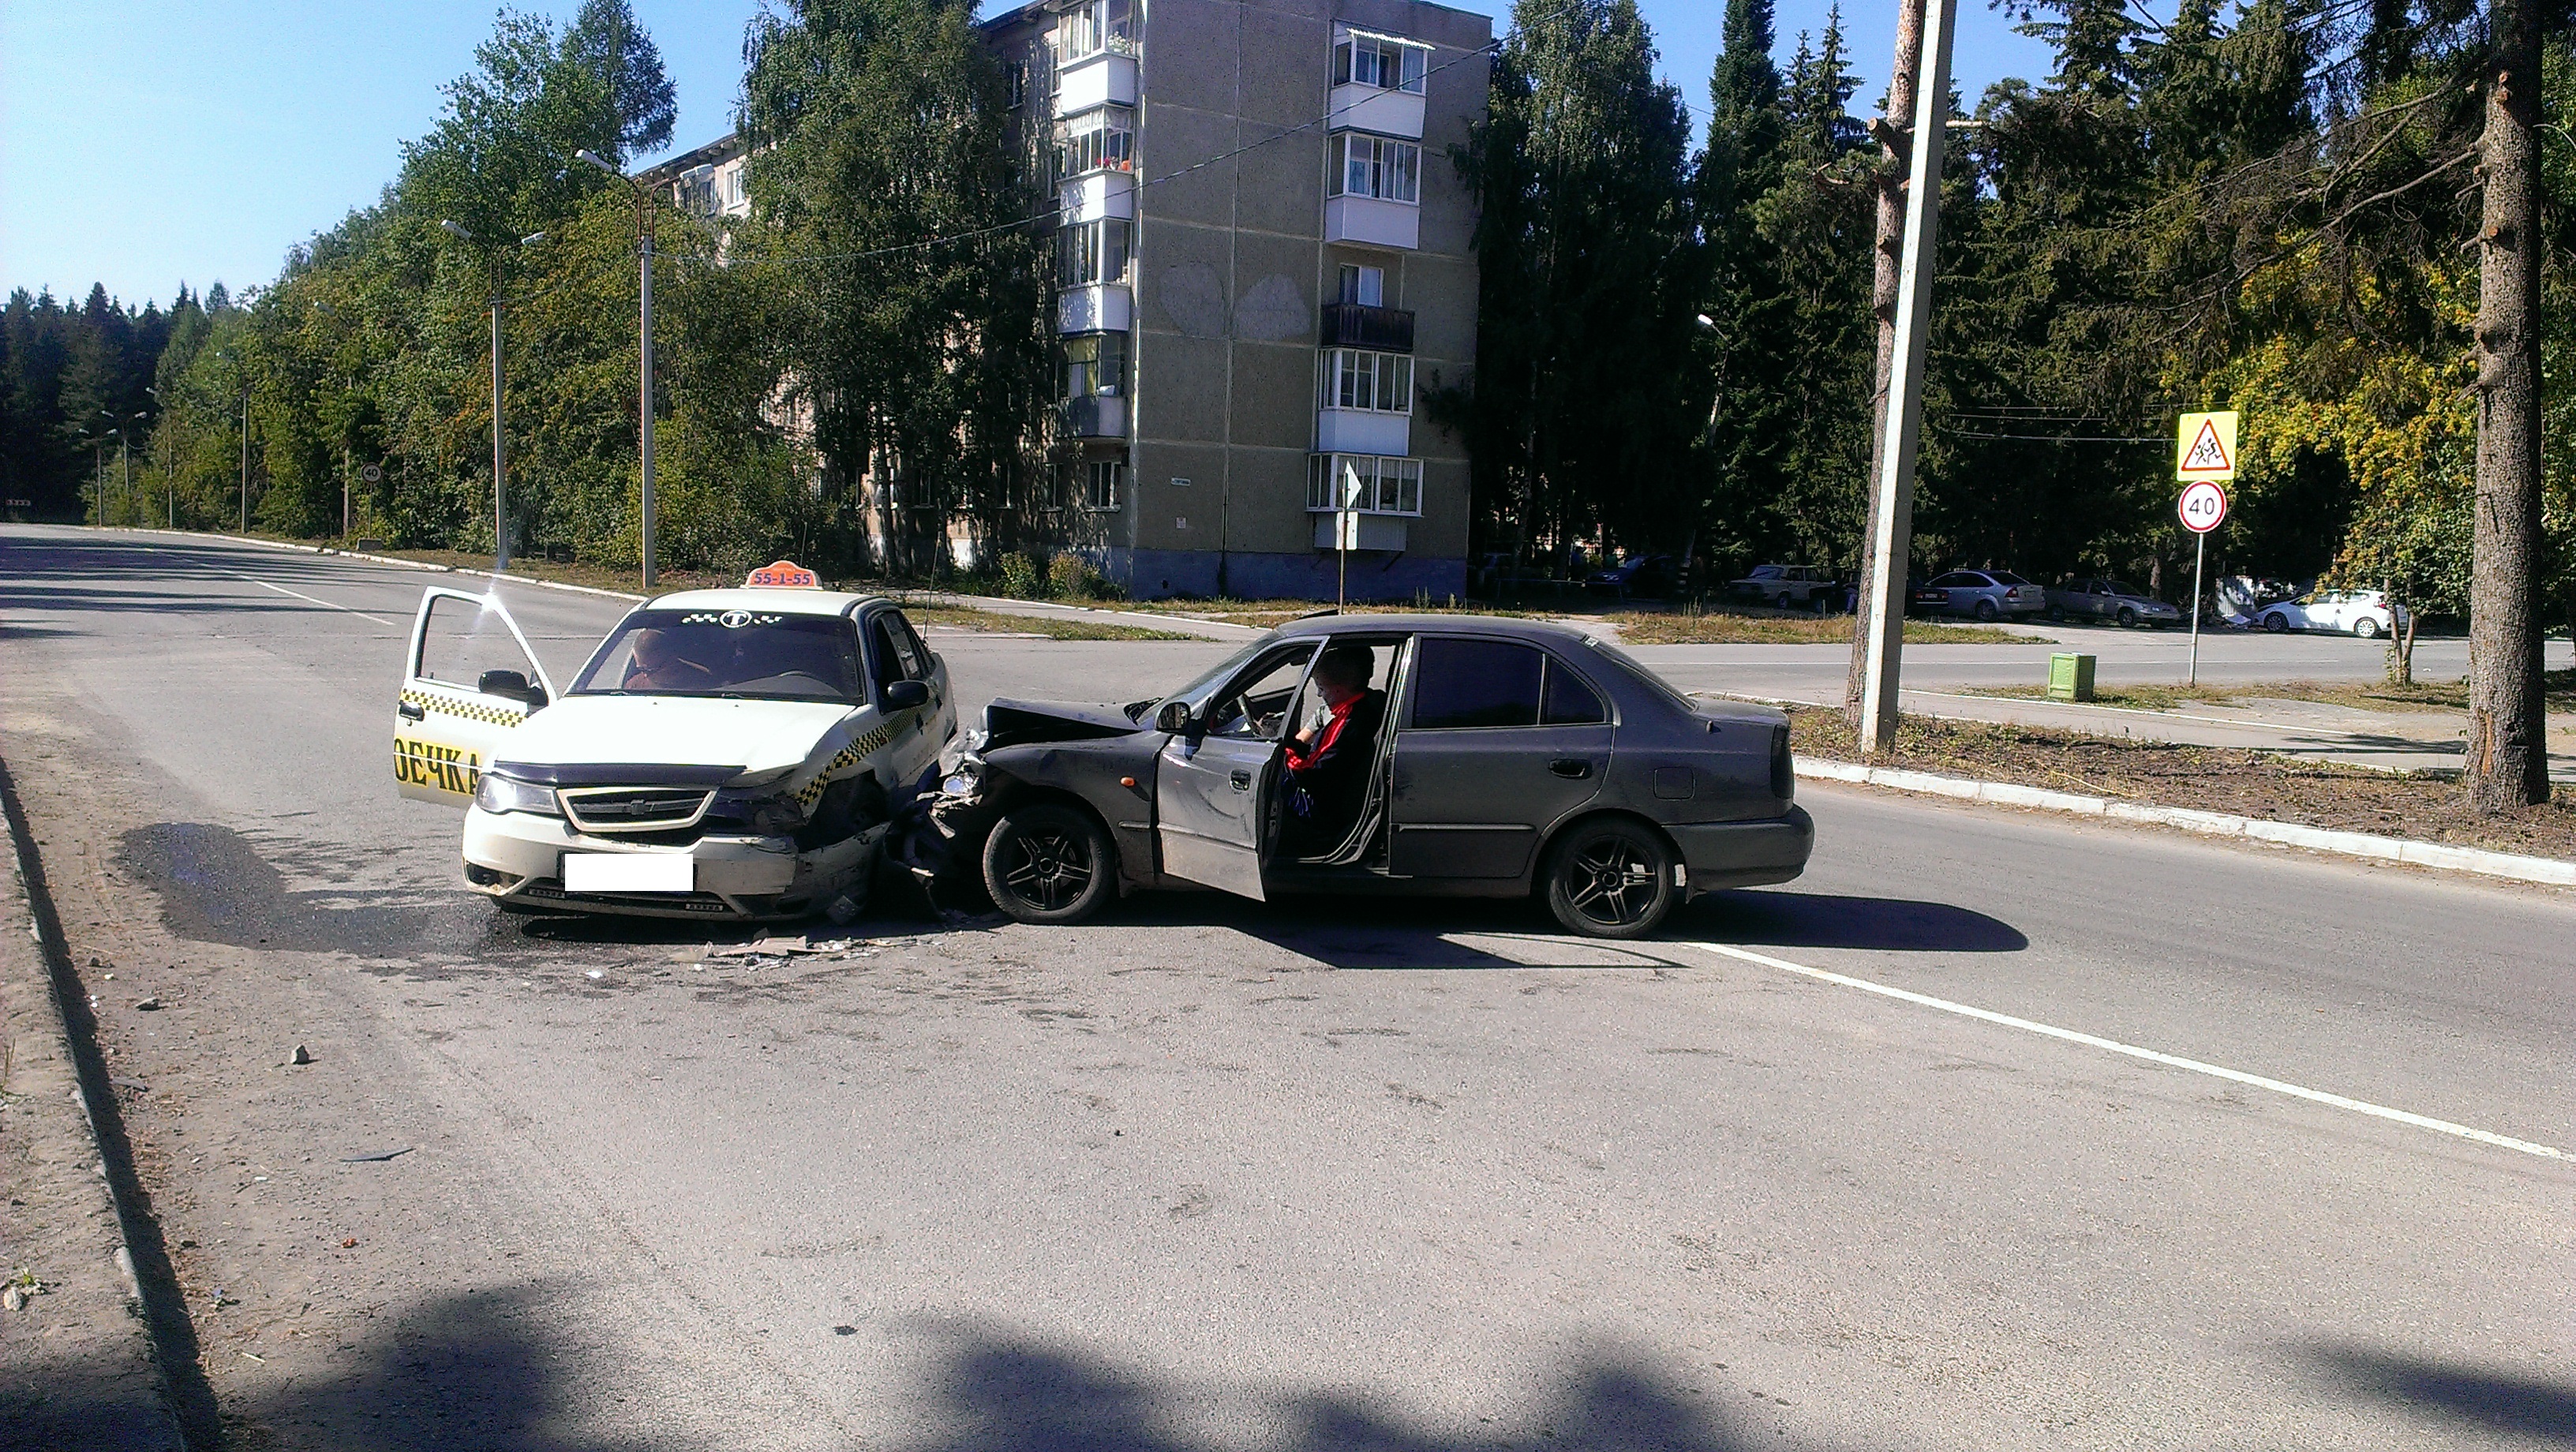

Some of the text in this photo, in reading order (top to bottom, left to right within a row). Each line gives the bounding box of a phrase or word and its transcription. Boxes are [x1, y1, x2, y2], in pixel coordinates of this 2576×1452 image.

[365, 469, 378, 477] 40
[2188, 497, 2215, 515] 40
[754, 572, 811, 585] 55-1-55
